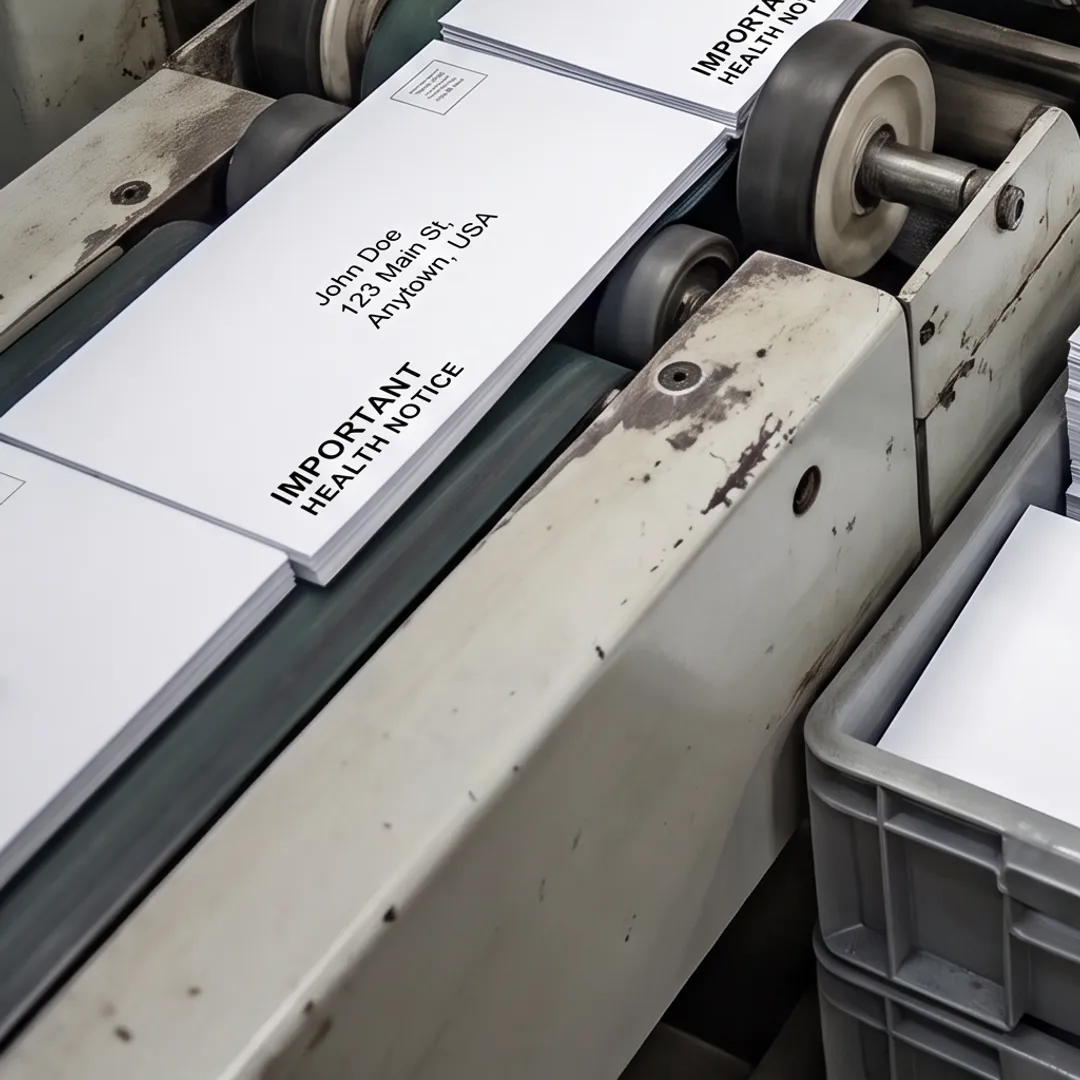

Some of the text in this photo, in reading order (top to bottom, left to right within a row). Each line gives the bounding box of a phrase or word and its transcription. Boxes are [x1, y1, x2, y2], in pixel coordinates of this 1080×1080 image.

[717, 25, 785, 86] HEALTH
[315, 229, 402, 307] John Doe
[341, 220, 455, 315] 123 Main St,
[367, 213, 499, 330] Anytown, USA
[270, 361, 422, 506] IMPORTANT
[299, 361, 465, 516] HEALTH NOTICE
